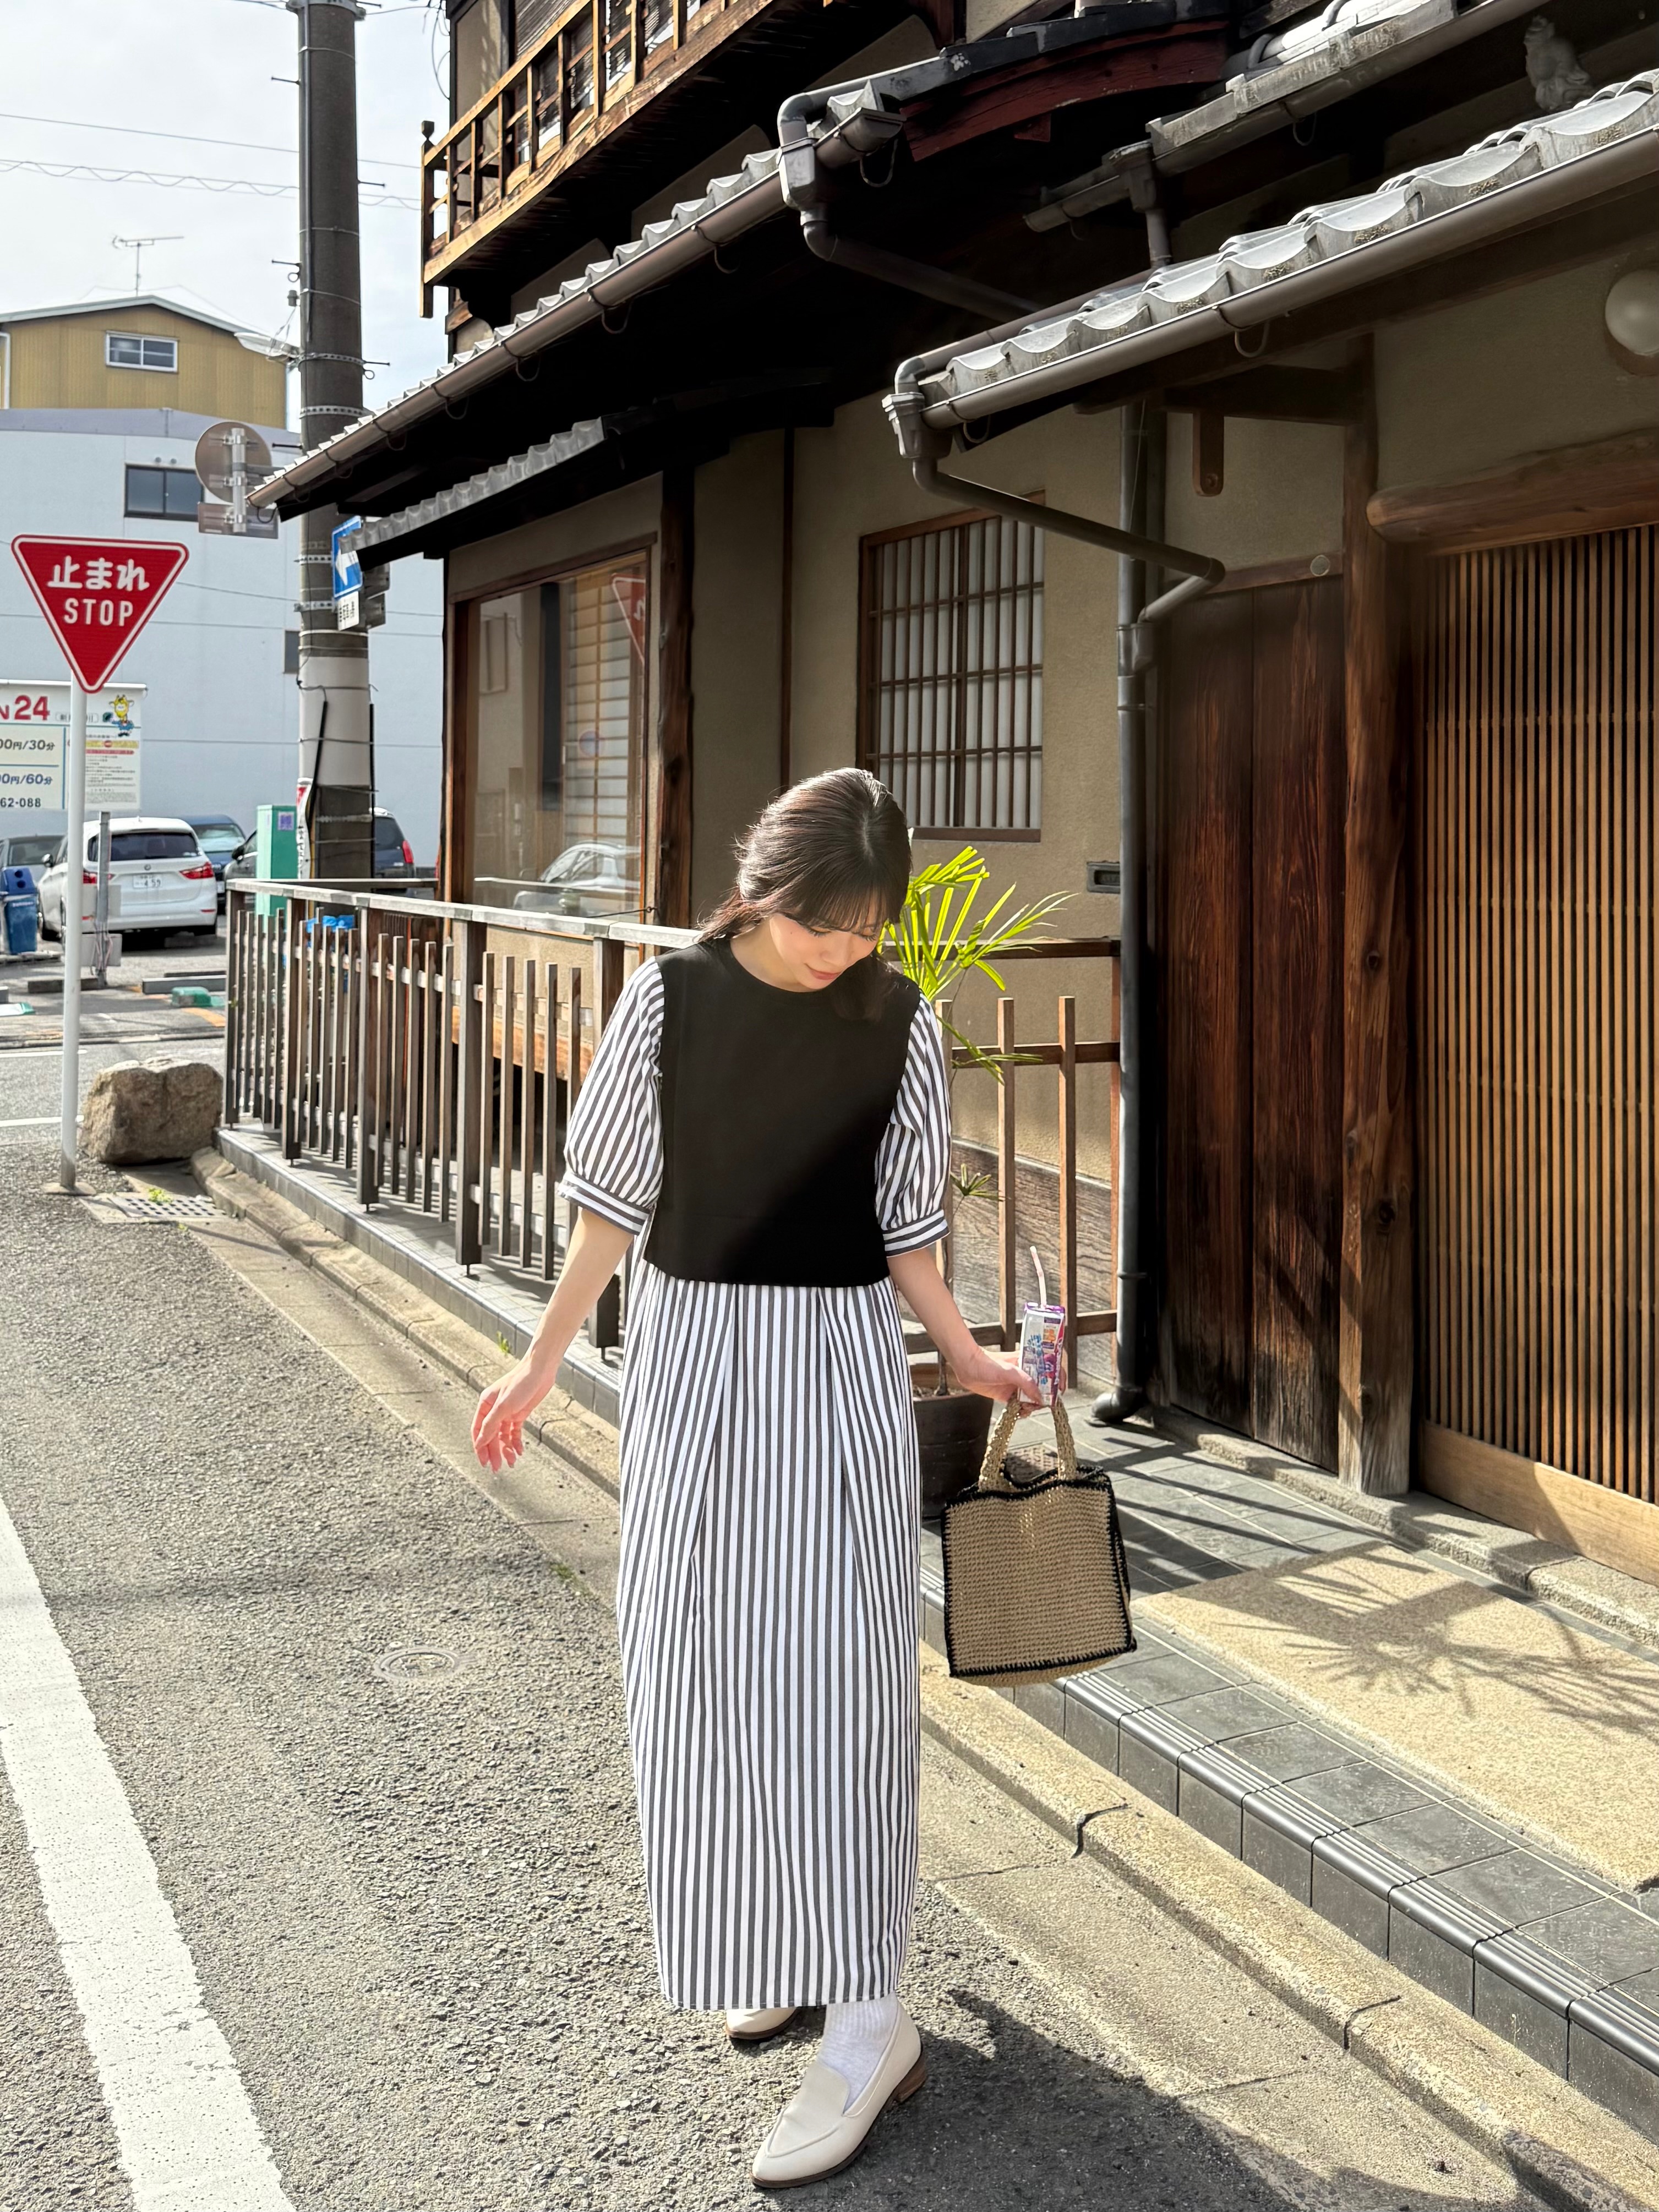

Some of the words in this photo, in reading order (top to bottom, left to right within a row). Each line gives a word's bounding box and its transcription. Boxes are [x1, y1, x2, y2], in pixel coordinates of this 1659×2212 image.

[47, 555, 150, 591] 止まれ
[64, 598, 133, 626] STOP
[14, 695, 50, 720] 24
[0, 773, 52, 785] 0円/60分
